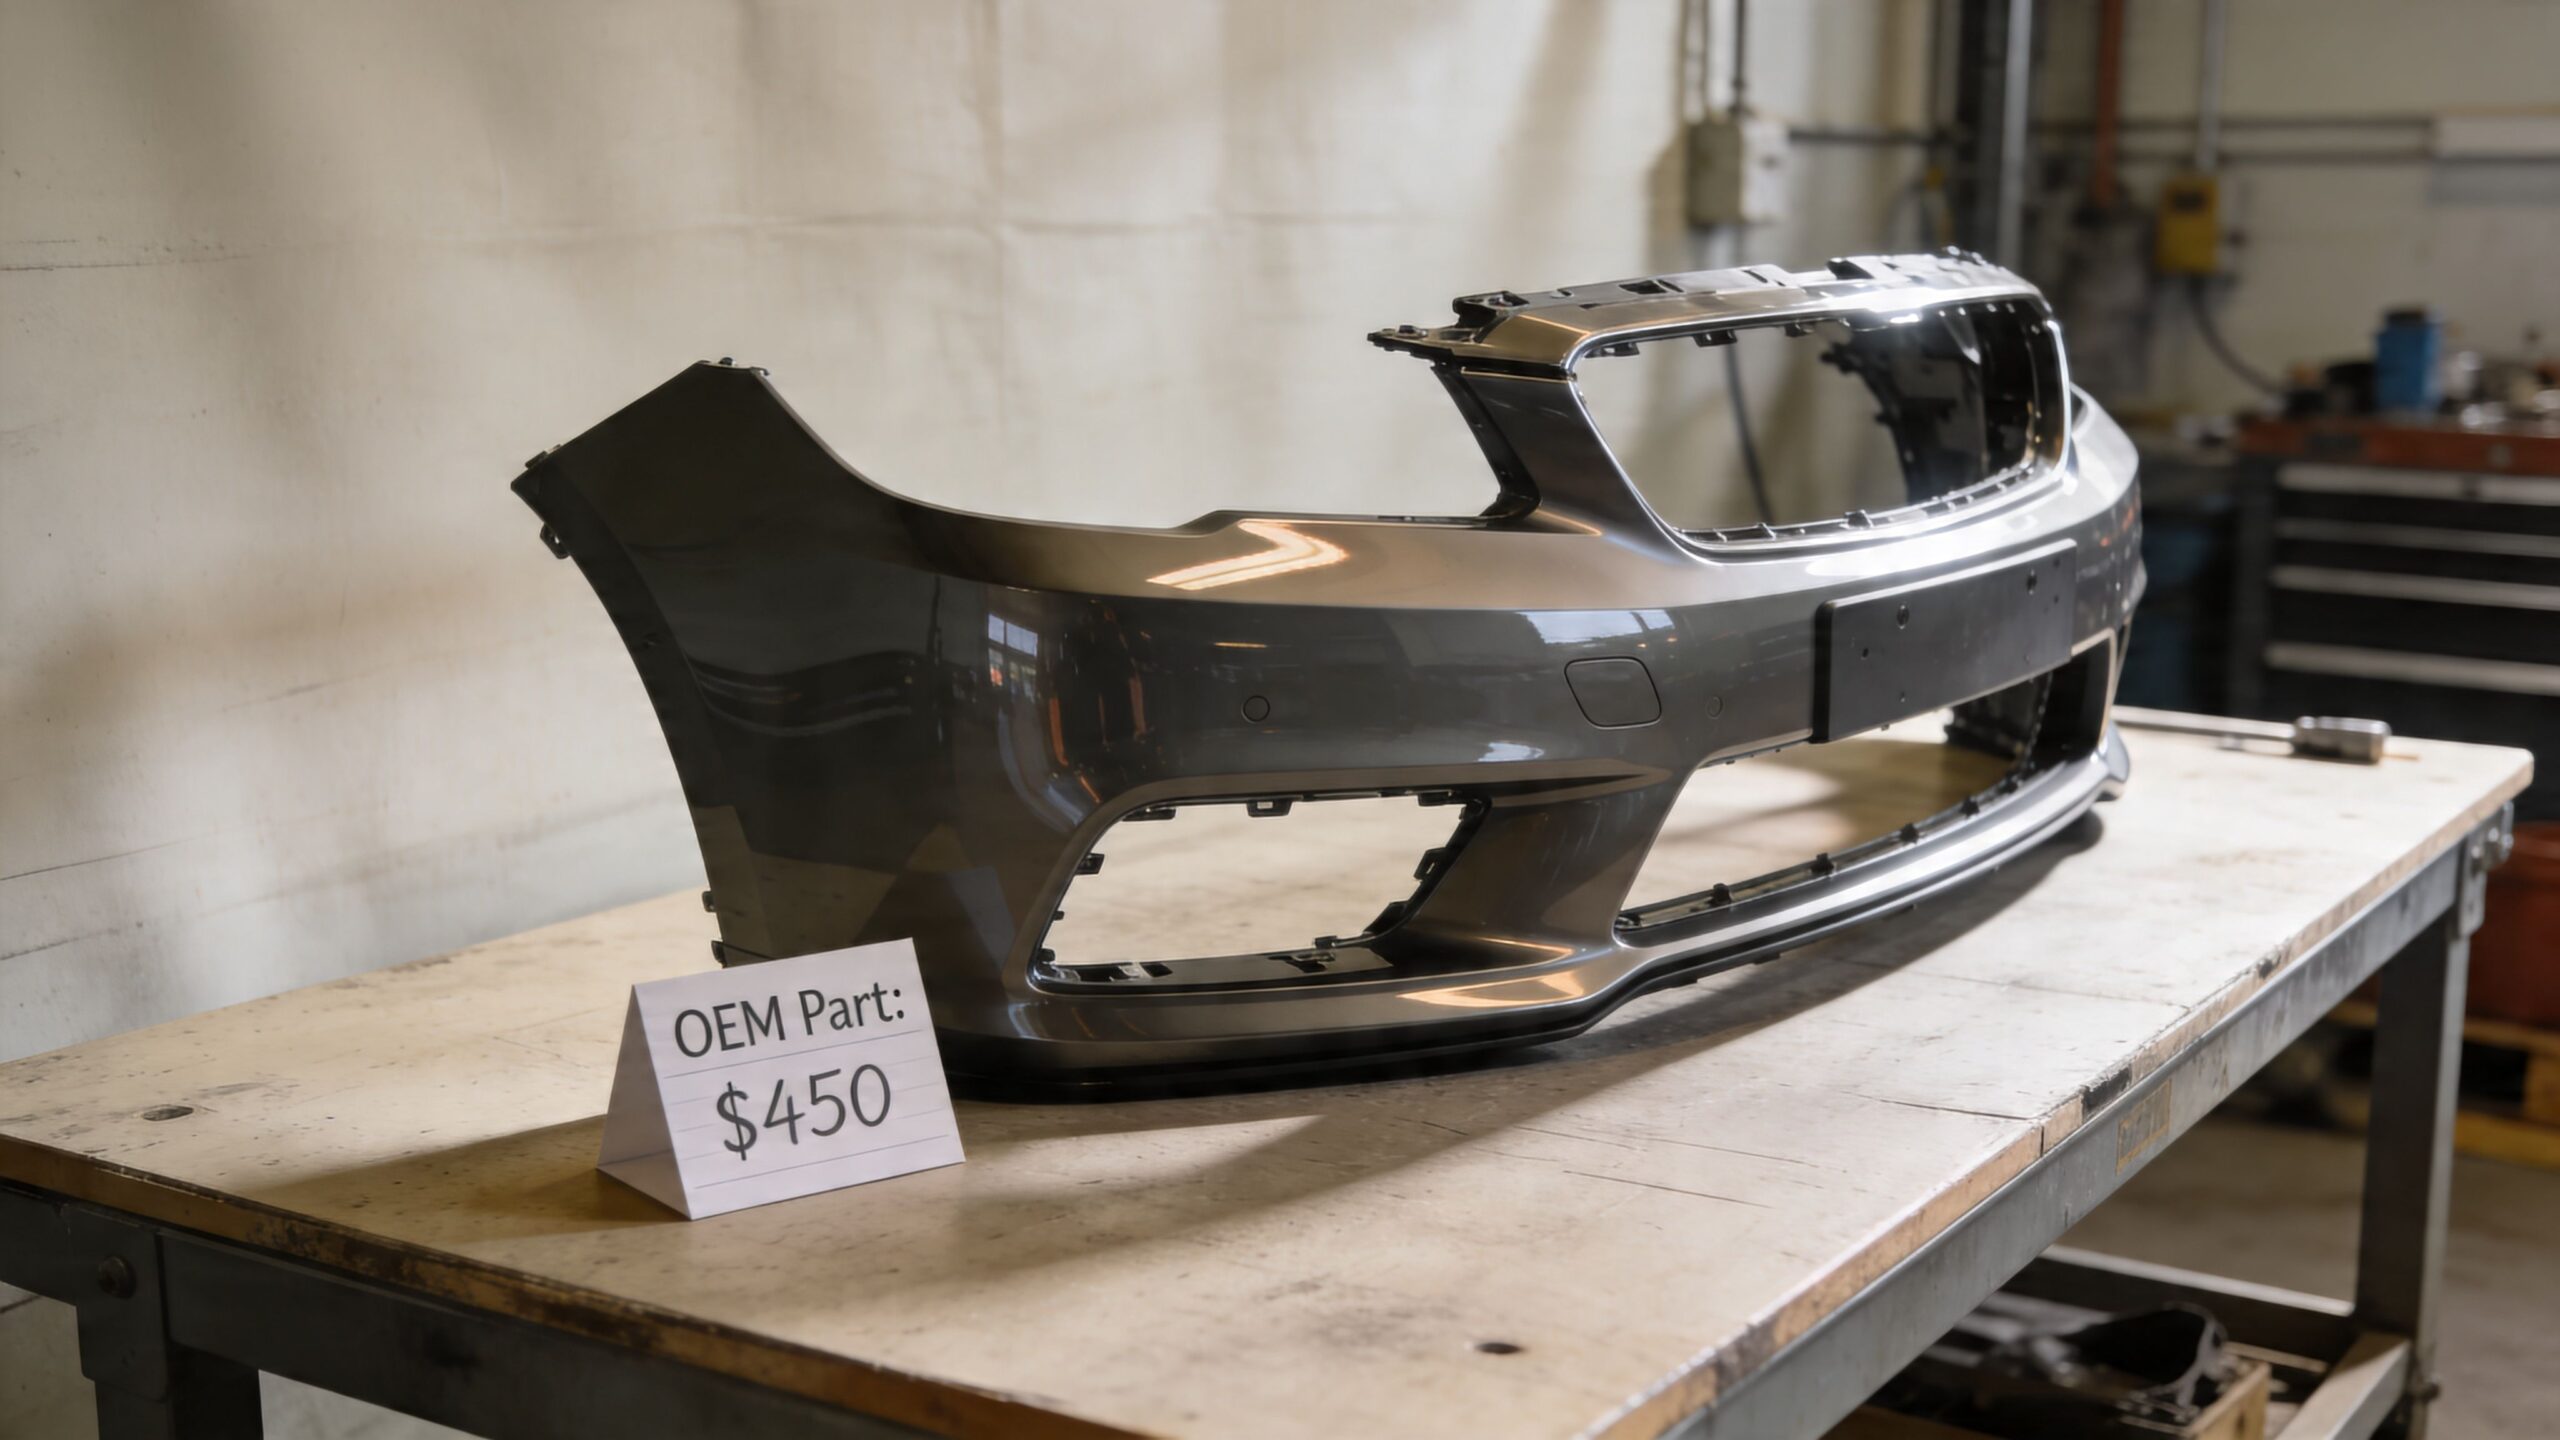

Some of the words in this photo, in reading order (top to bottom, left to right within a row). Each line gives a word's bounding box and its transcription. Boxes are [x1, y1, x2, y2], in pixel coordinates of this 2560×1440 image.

[674, 995, 786, 1058] OEM
[798, 981, 905, 1036] Part:
[716, 1063, 891, 1161] $450
